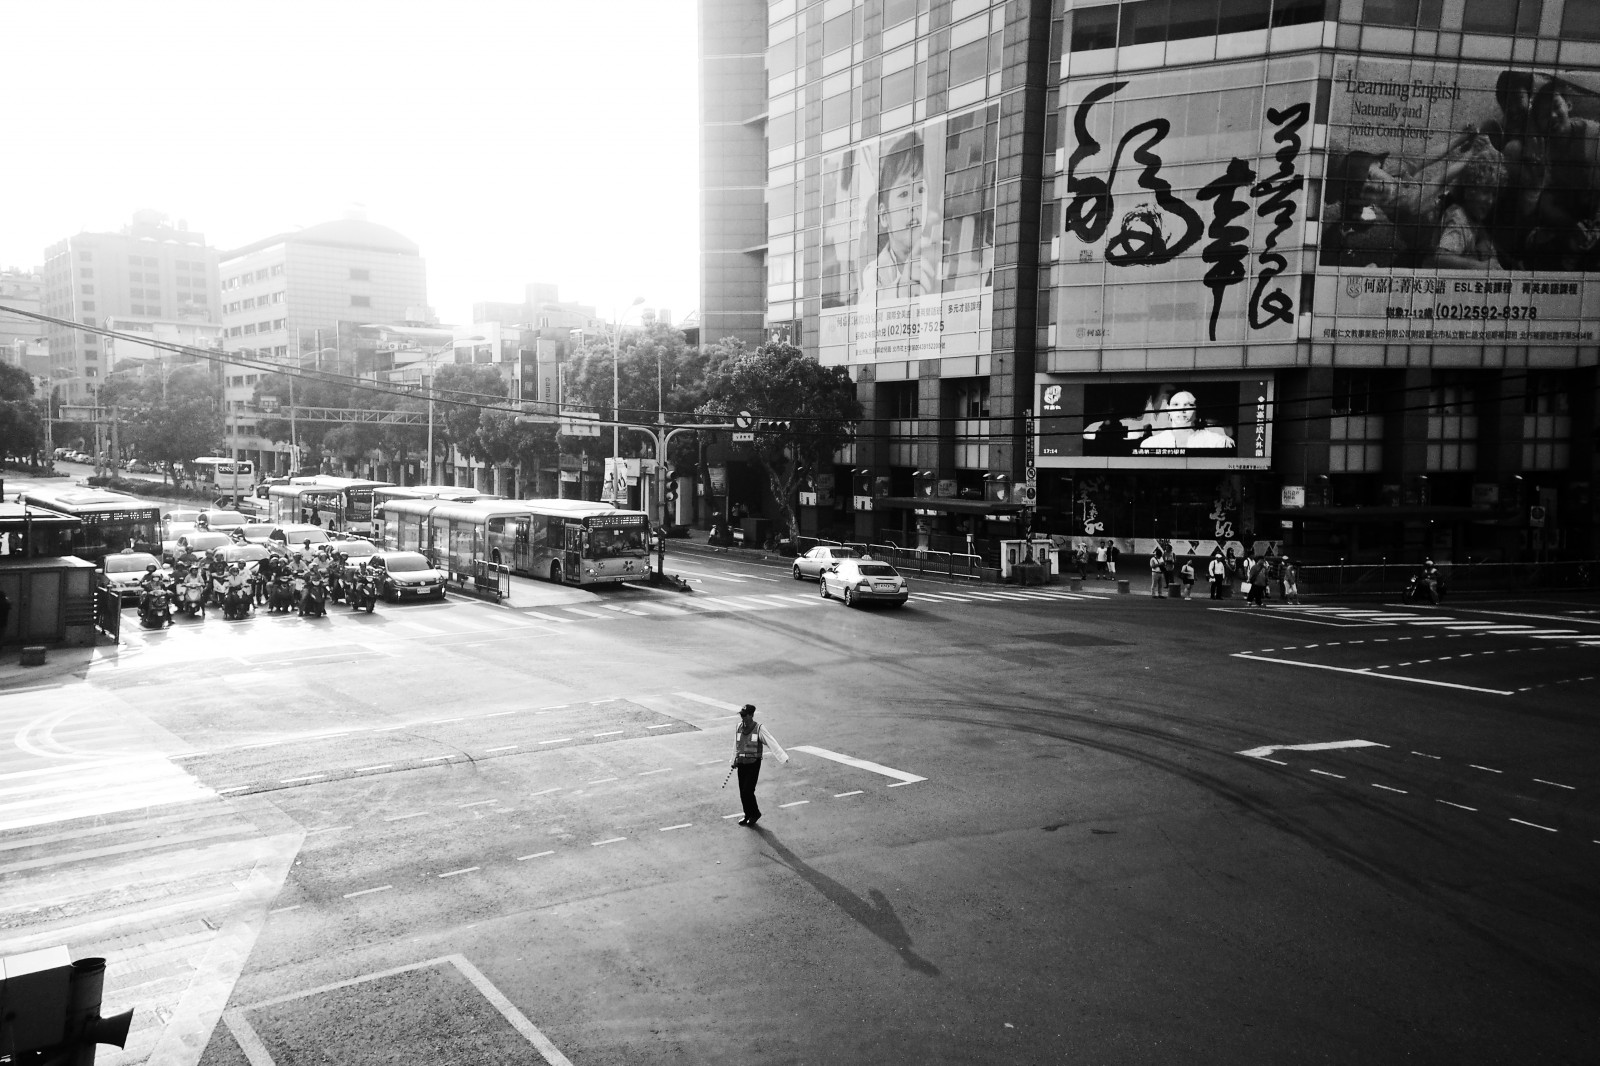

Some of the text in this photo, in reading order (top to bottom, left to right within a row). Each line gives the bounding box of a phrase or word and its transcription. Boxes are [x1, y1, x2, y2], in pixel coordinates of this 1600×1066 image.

[1345, 69, 1461, 103] Learning English
[1354, 101, 1422, 120] Naturally and
[1454, 282, 1472, 292] ESL
[1435, 303, 1538, 321] (02)2592-8378
[887, 320, 945, 337] (02)2592-7525
